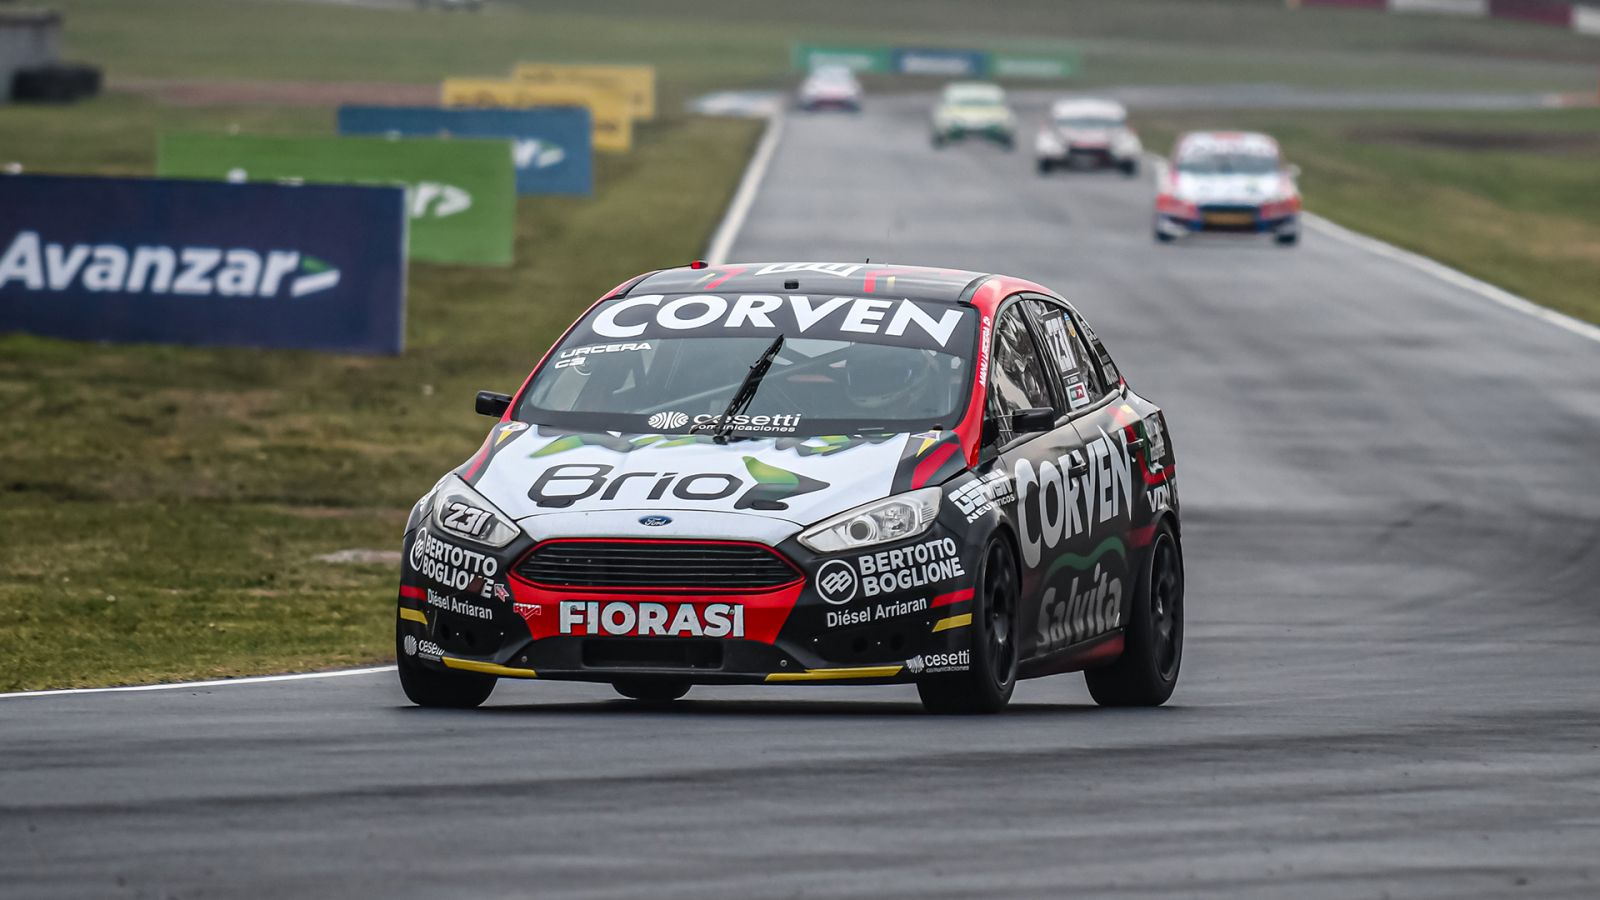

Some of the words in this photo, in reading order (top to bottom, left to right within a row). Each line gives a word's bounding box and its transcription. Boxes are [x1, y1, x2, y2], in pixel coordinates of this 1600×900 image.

[0, 230, 300, 297] Avanzar
[592, 294, 965, 348] CORVEN
[560, 342, 653, 359] URCERA
[527, 463, 744, 504] Brio
[1014, 424, 1133, 569] CORVEN
[442, 502, 495, 536] 231
[966, 493, 1016, 524] NEUTICOS
[424, 534, 499, 577] BERTOTTO
[858, 537, 958, 576] BERTOTTO
[422, 555, 495, 599] BOGLIOE
[862, 556, 966, 597] BOGLIONE
[427, 588, 450, 610] Diésel
[451, 598, 493, 620] Arriaran
[559, 601, 745, 637] FIORASI
[826, 607, 871, 628] Diésel
[874, 597, 927, 620] Arriaran
[1036, 562, 1123, 647] Salvita
[924, 650, 970, 667] cesetti
